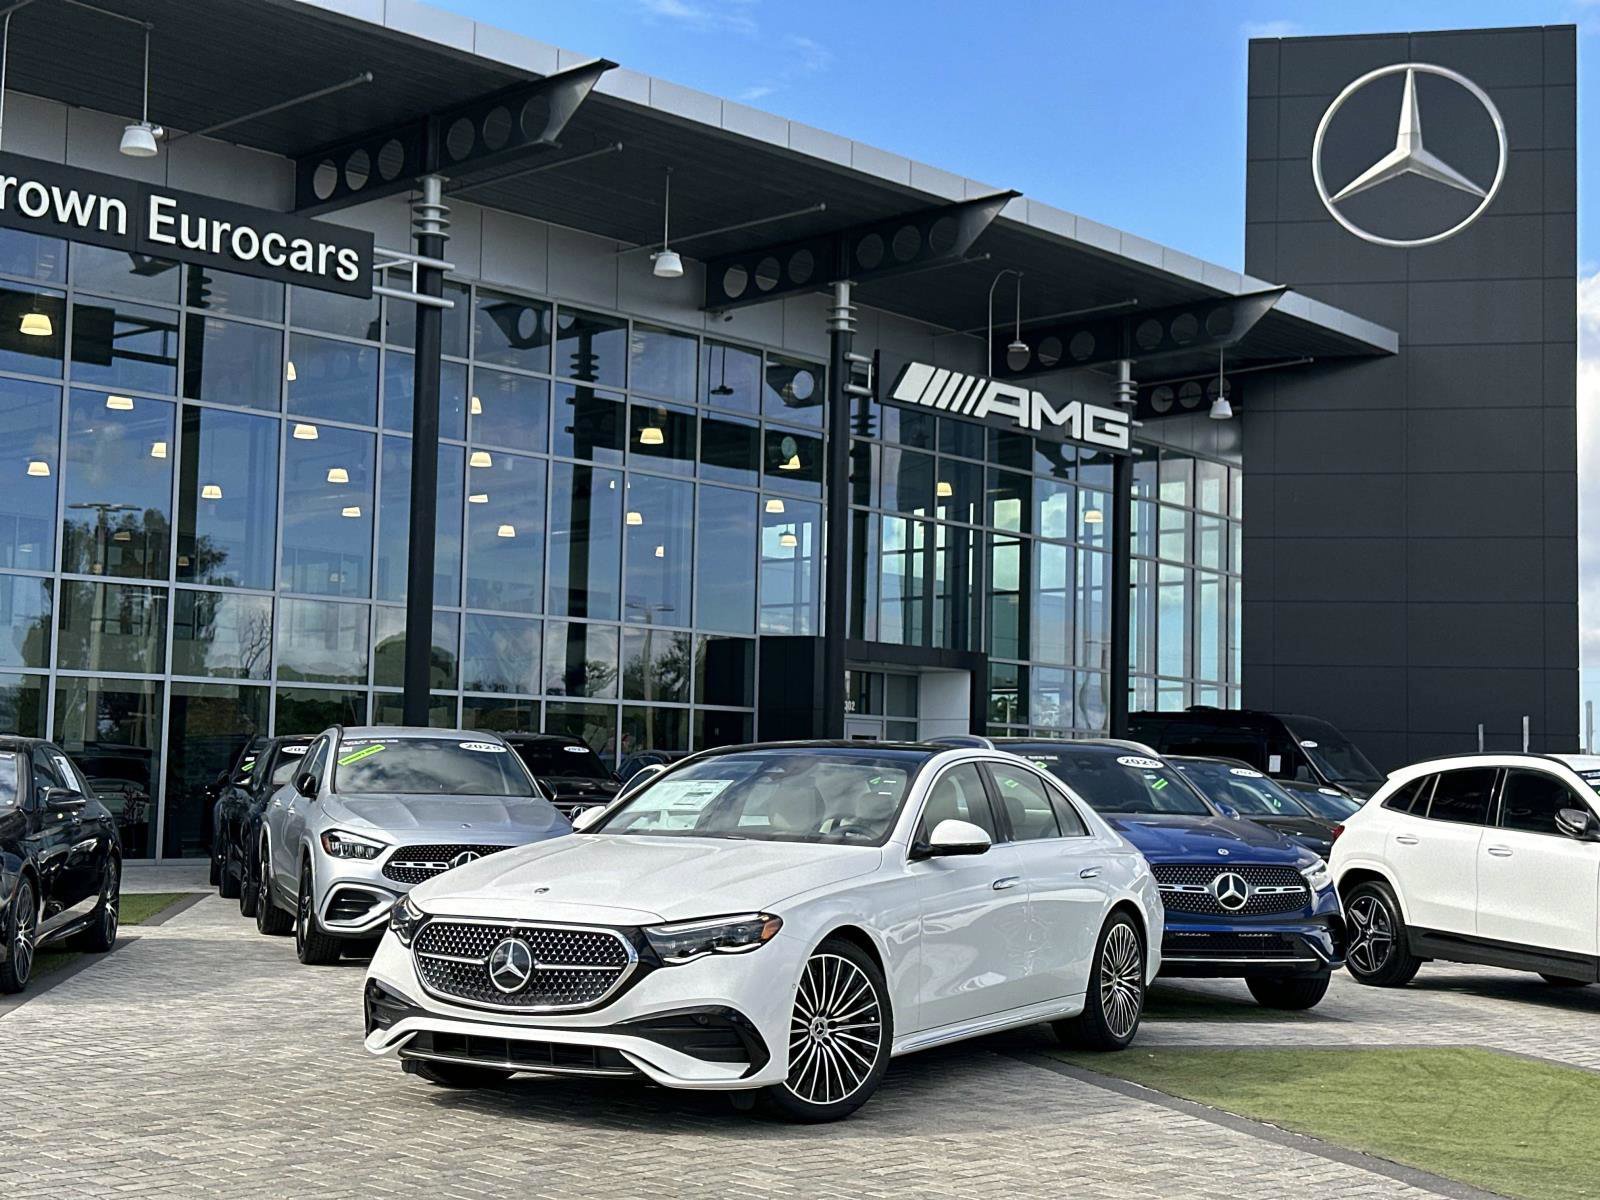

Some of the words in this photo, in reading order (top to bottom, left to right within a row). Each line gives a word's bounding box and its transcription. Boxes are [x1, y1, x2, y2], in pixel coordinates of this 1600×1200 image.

[148, 194, 360, 282] Eurocars
[973, 381, 1129, 450] AMG
[1121, 757, 1160, 768] 2025
